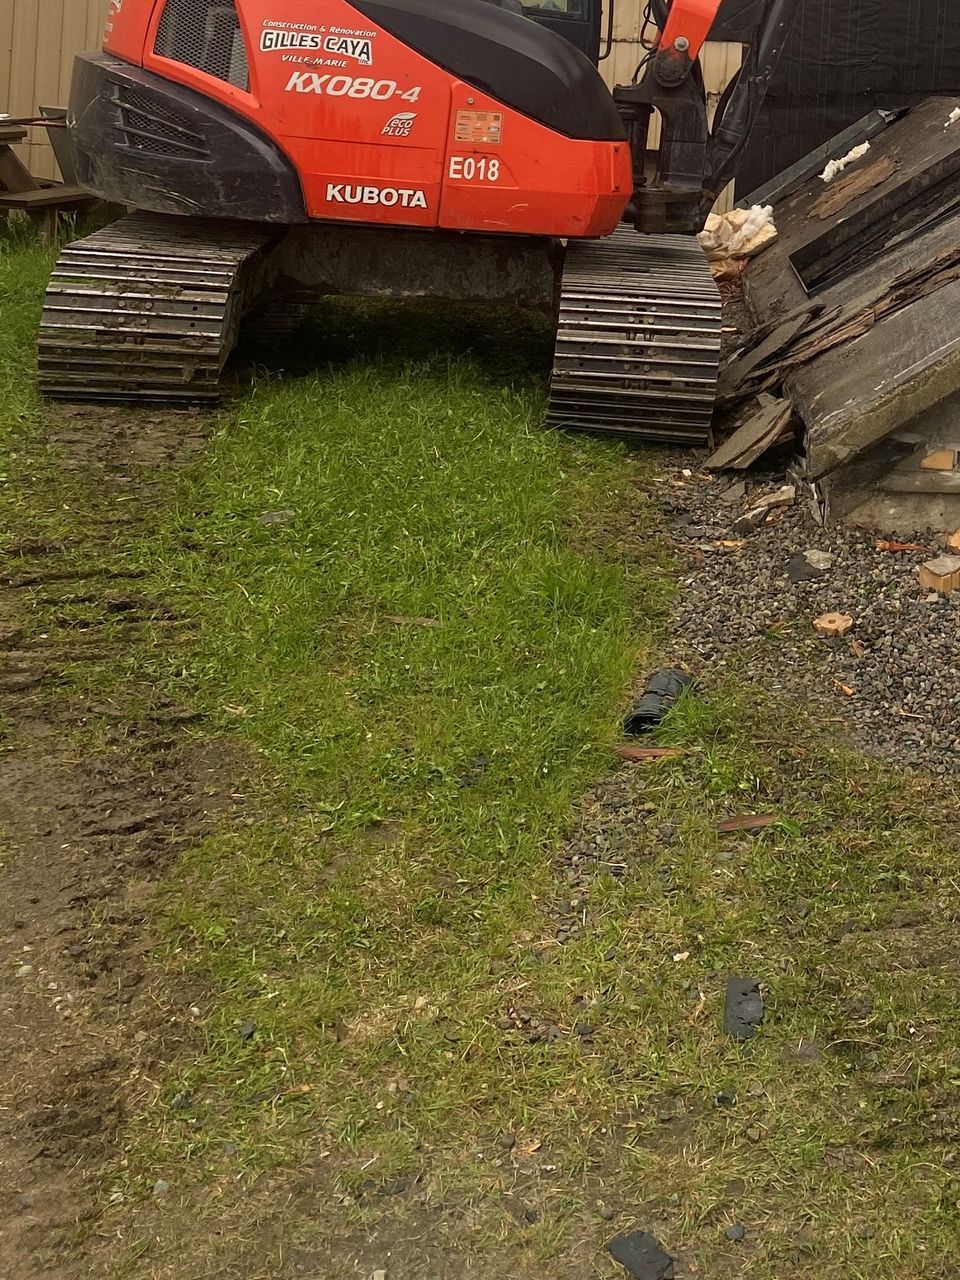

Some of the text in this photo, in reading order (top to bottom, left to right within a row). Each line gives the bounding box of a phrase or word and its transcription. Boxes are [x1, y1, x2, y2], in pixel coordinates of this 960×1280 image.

[263, 19, 317, 31] Construction
[261, 31, 371, 60] GILLES CAYA
[281, 54, 348, 68] VILLE-MARIE
[285, 71, 422, 103] KX080-4
[381, 126, 410, 136] PLUS
[391, 119, 413, 128] eco
[449, 156, 499, 181] E018
[326, 183, 428, 208] KUBOTA
